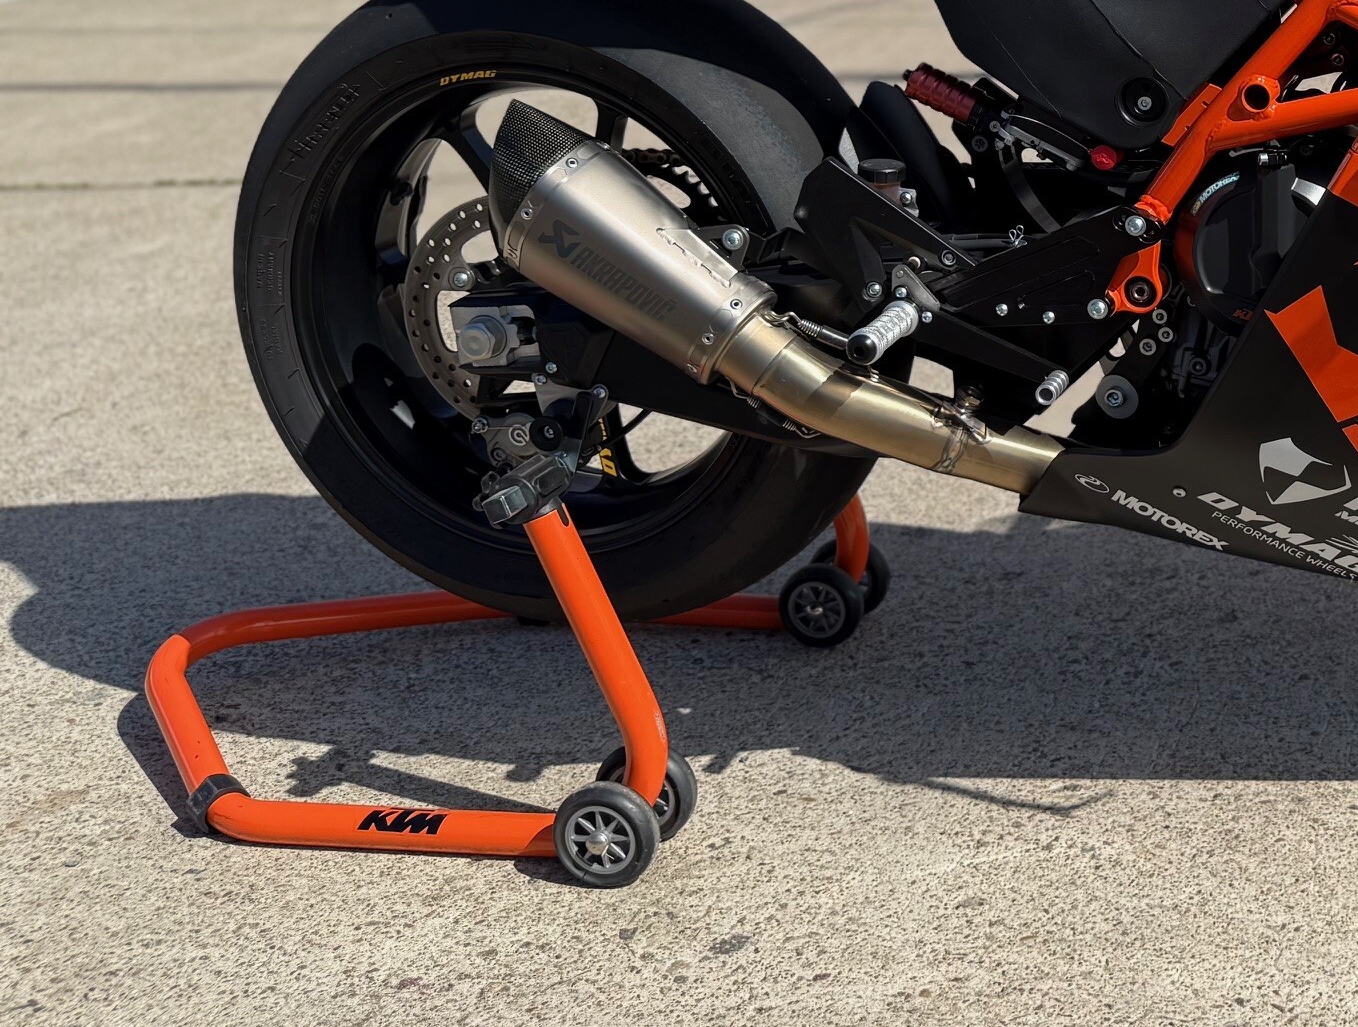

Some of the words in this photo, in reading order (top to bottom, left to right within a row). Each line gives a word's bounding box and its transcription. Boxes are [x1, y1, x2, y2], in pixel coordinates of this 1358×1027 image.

[439, 69, 497, 86] DYMAG
[1111, 489, 1230, 551] MOTOREX
[1212, 510, 1305, 560] PERFORMANCE
[357, 807, 448, 835] KTM
